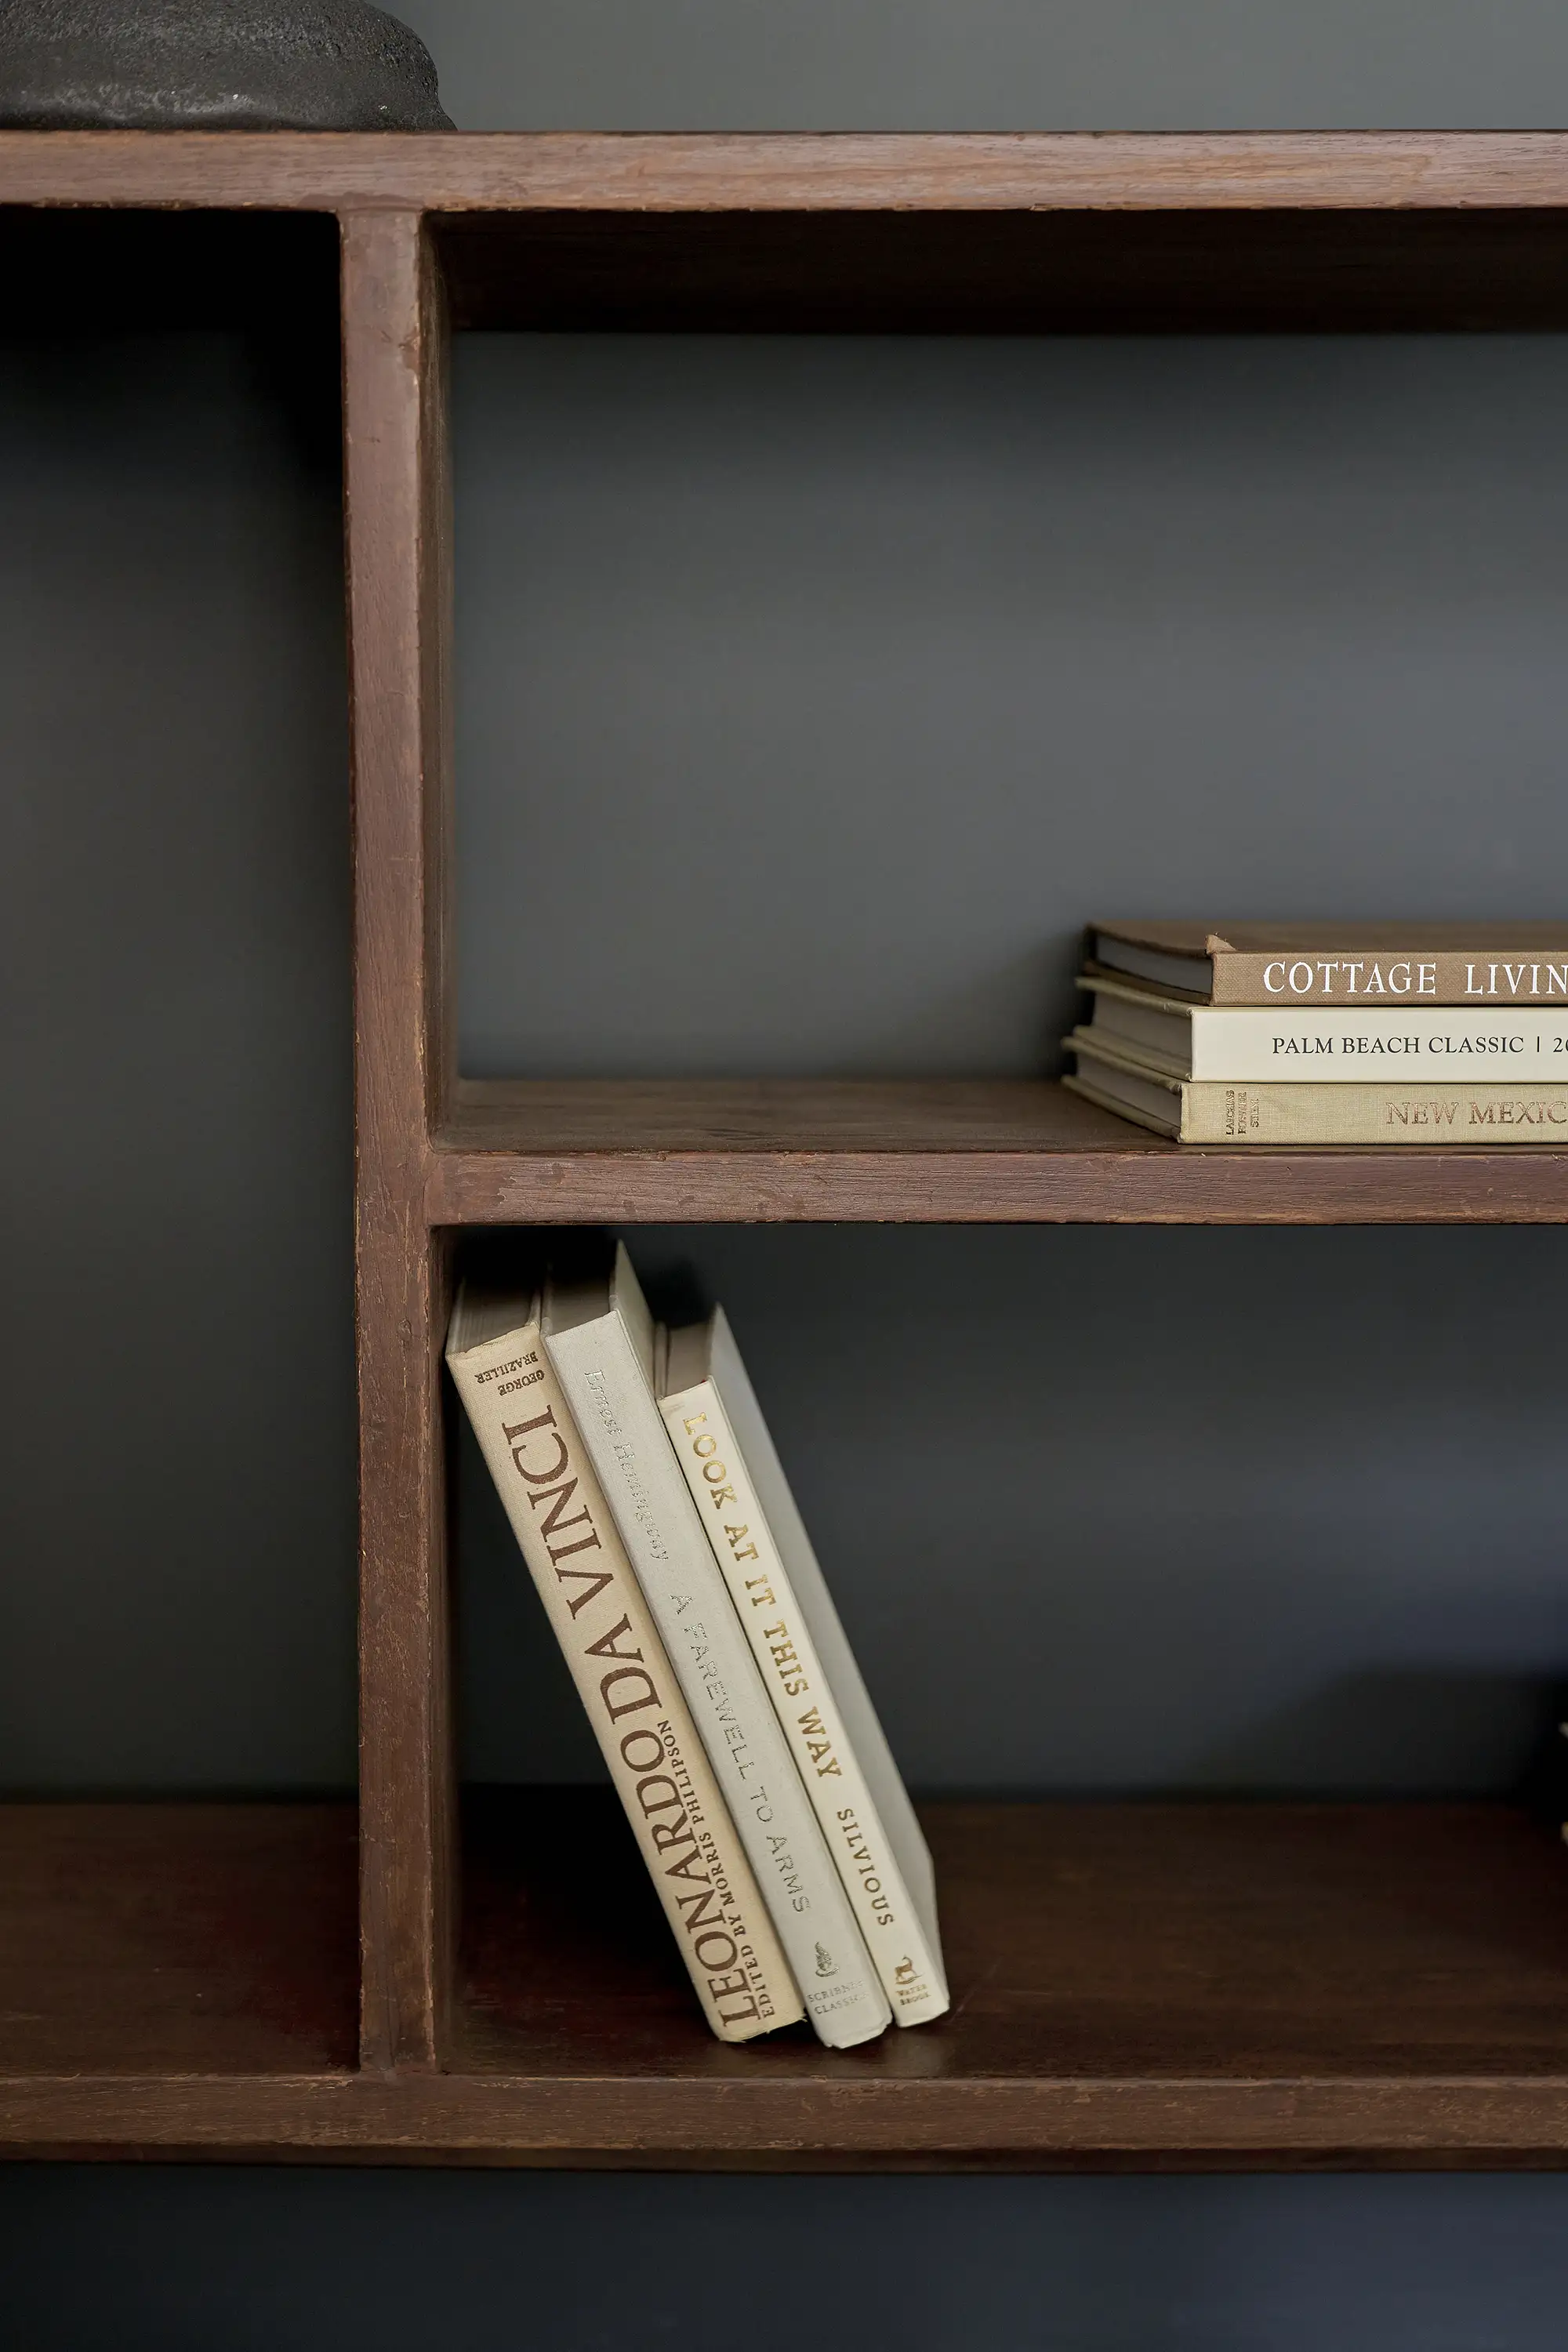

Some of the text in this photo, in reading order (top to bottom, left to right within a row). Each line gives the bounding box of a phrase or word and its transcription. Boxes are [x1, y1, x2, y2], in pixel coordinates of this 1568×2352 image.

[1263, 960, 1436, 994] COTTAGE
[1272, 1037, 1334, 1054] PALM
[1341, 1036, 1421, 1054] BEACH
[1428, 1036, 1524, 1054] CLASSIC
[1385, 1102, 1459, 1125] NEW
[474, 1351, 539, 1385] BRAZILLER
[497, 1369, 546, 1396] GEORGE
[584, 1369, 811, 1914] Ernest Hemingway A FAREWELL TO ARMS
[683, 1411, 895, 1927] LOOK AT IT THIS WAY SILVIOUS
[502, 1404, 761, 2027] LEONARDO DA VINCI
[657, 1719, 775, 2019] EDITED BY MORRIS PHILIPSON
